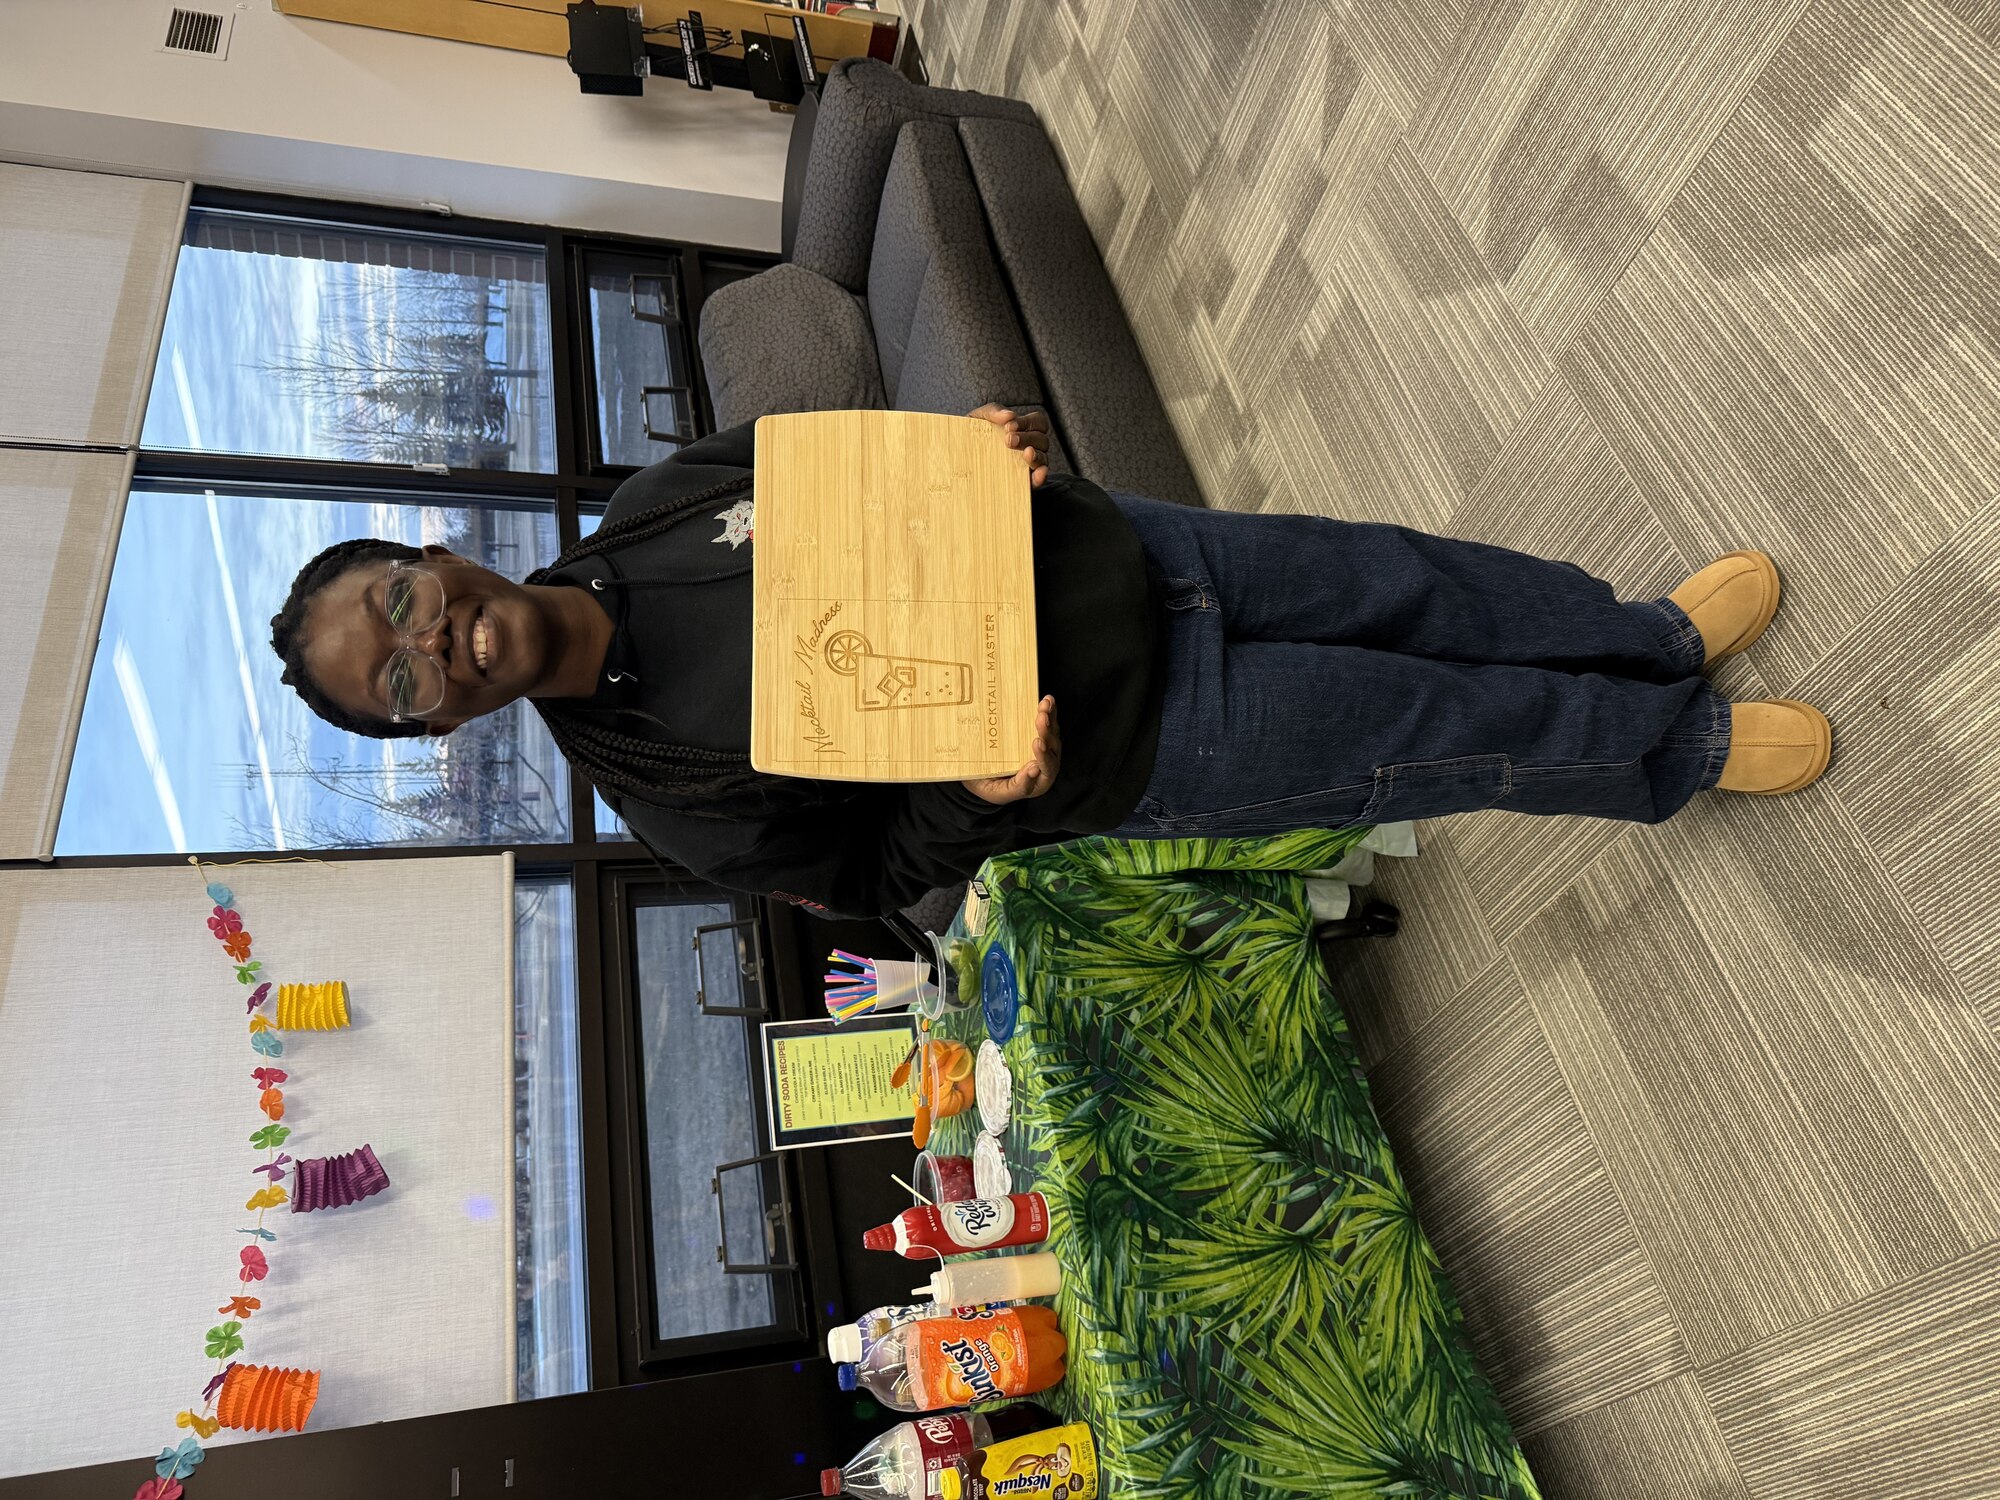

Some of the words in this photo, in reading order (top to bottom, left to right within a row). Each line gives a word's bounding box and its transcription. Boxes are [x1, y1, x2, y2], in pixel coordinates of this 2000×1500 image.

[794, 601, 842, 675] Madness
[986, 614, 996, 670] MASTER
[795, 680, 846, 754] Mocktail
[987, 676, 998, 749] MOCKTAIL
[778, 1040, 788, 1075] RECIPES
[781, 1077, 790, 1101] SODA
[784, 1103, 793, 1128] DIRTY
[941, 1339, 1004, 1403] Sunkist
[974, 1338, 999, 1372] Orange
[994, 1473, 1051, 1495] Nesquik
